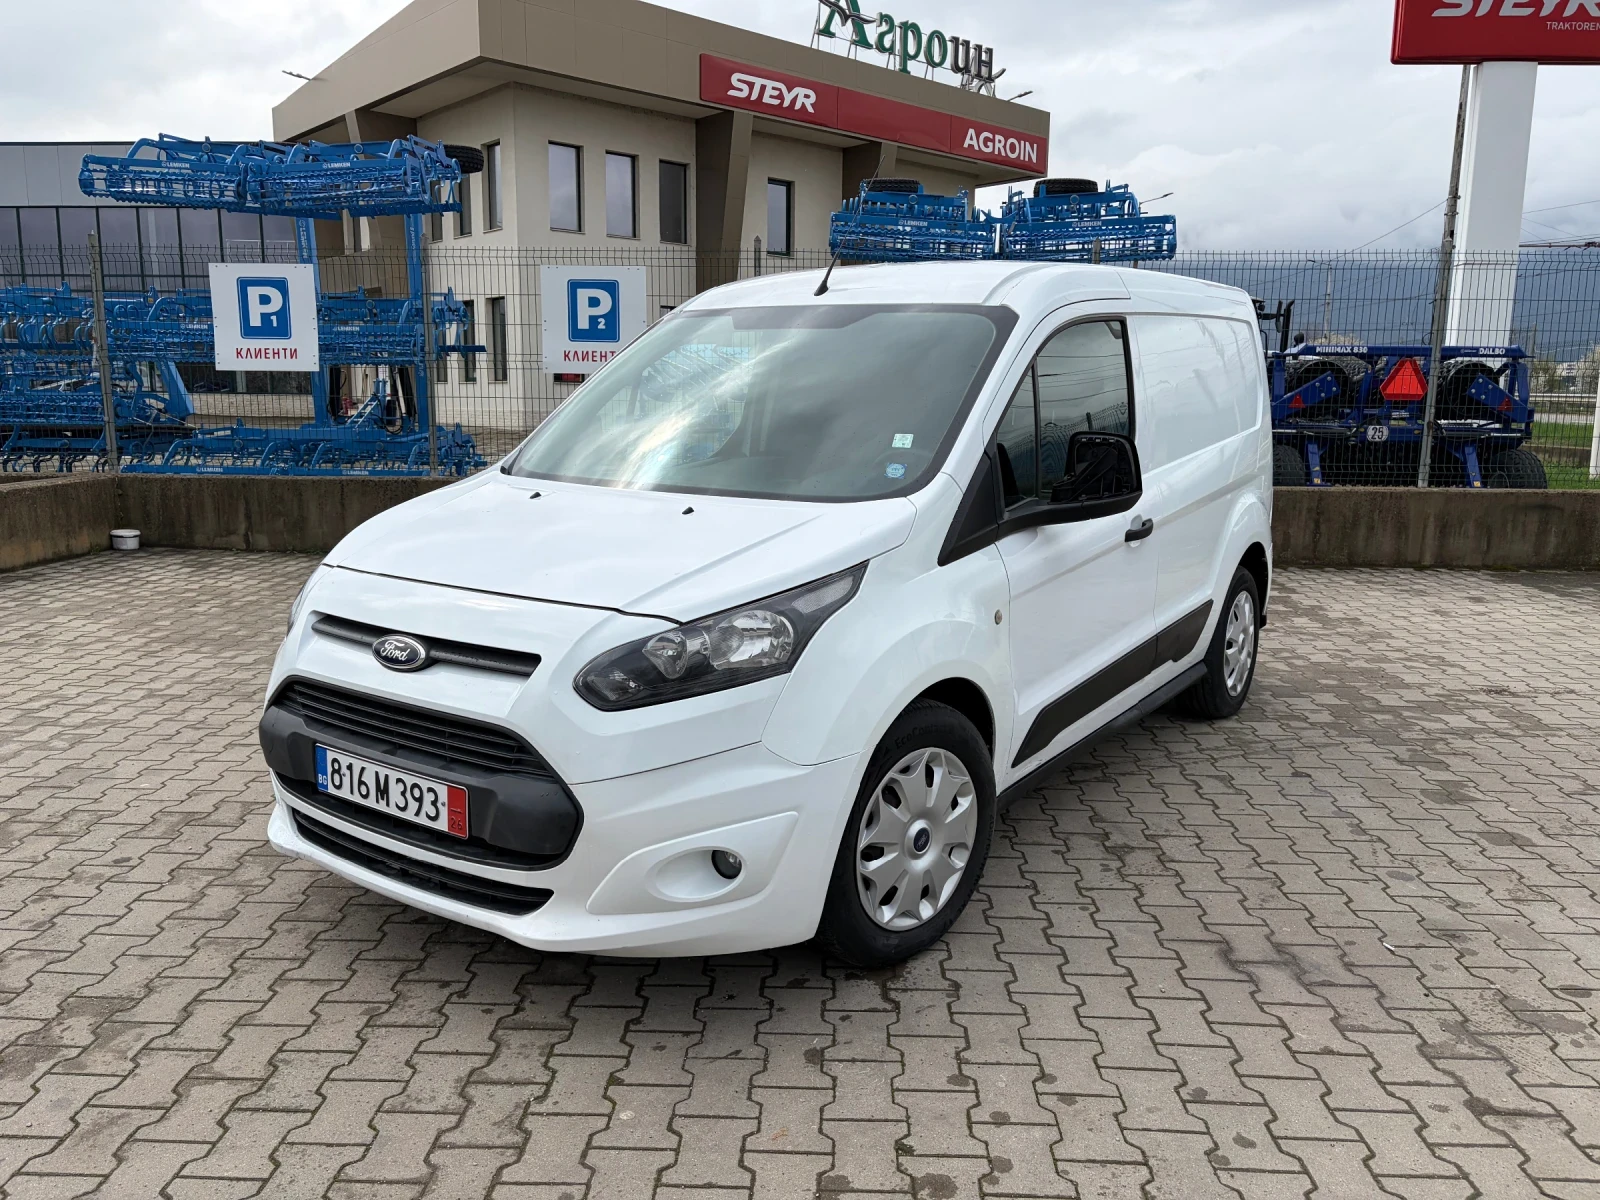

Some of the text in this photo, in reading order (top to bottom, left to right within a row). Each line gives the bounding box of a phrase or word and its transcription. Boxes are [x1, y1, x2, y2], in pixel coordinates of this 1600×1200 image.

[726, 72, 817, 114] STEYR
[963, 127, 1038, 164] AGROIN
[235, 347, 298, 359] КЛИЕНТИ
[563, 350, 617, 362] КЛИЕНТ
[1371, 427, 1384, 440] 25
[380, 640, 410, 661] Ford
[318, 773, 328, 785] BG
[450, 815, 463, 831] 26
